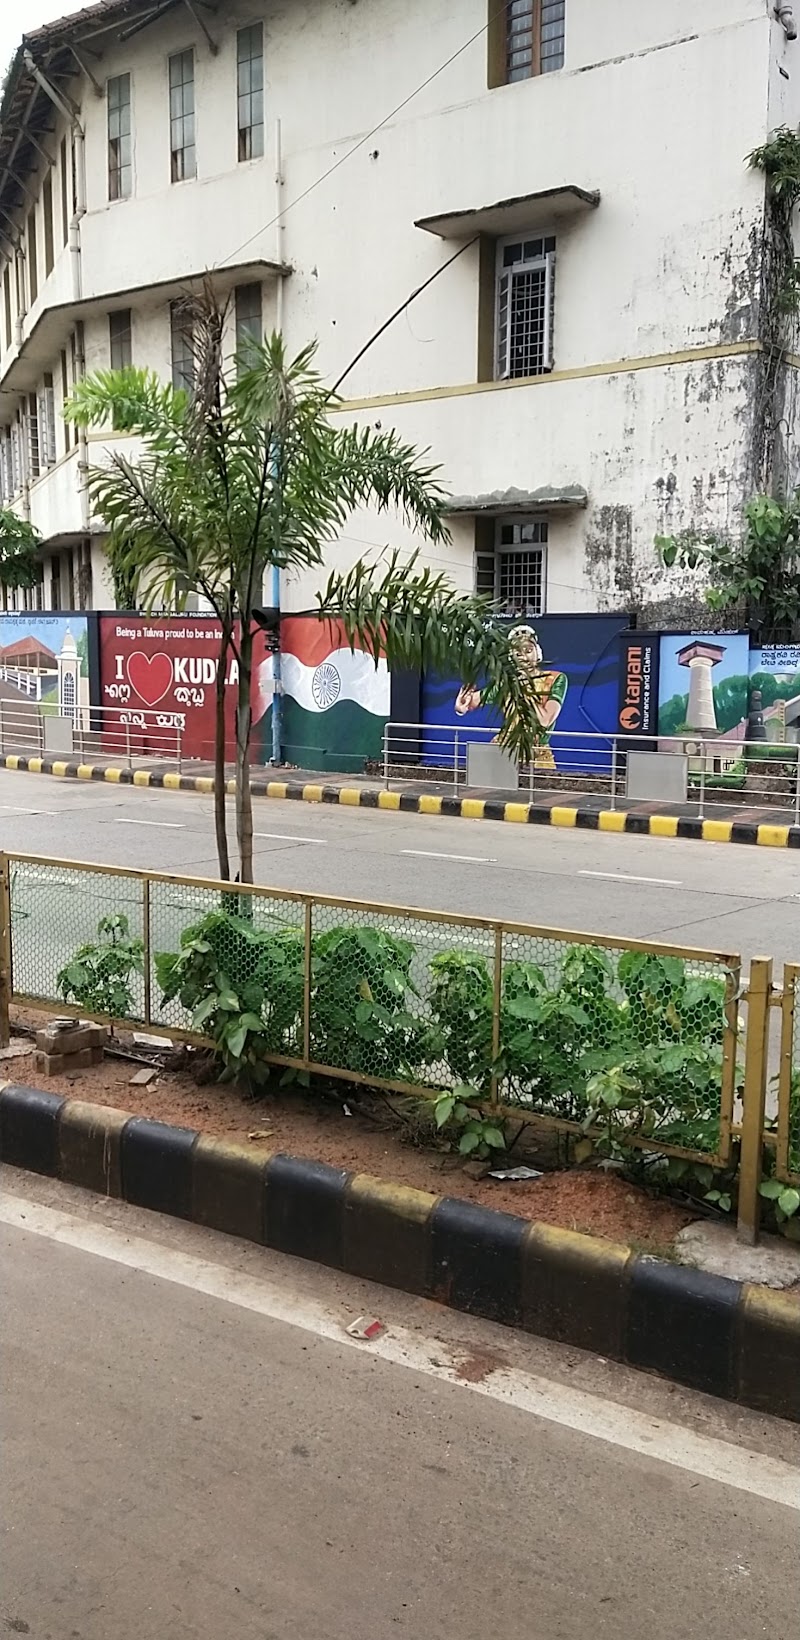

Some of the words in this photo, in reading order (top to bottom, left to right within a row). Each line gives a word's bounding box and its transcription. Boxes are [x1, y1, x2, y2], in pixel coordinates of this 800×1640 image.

[116, 626, 136, 640] Being
[143, 627, 164, 638] Tuluva
[165, 628, 185, 640] proud
[186, 628, 194, 638] to
[195, 628, 204, 639] be
[205, 630, 213, 639] an
[115, 655, 124, 680] I
[643, 647, 652, 672] Claims
[624, 646, 643, 705] tarjani
[643, 673, 651, 689] and
[642, 690, 651, 730] Insurance
